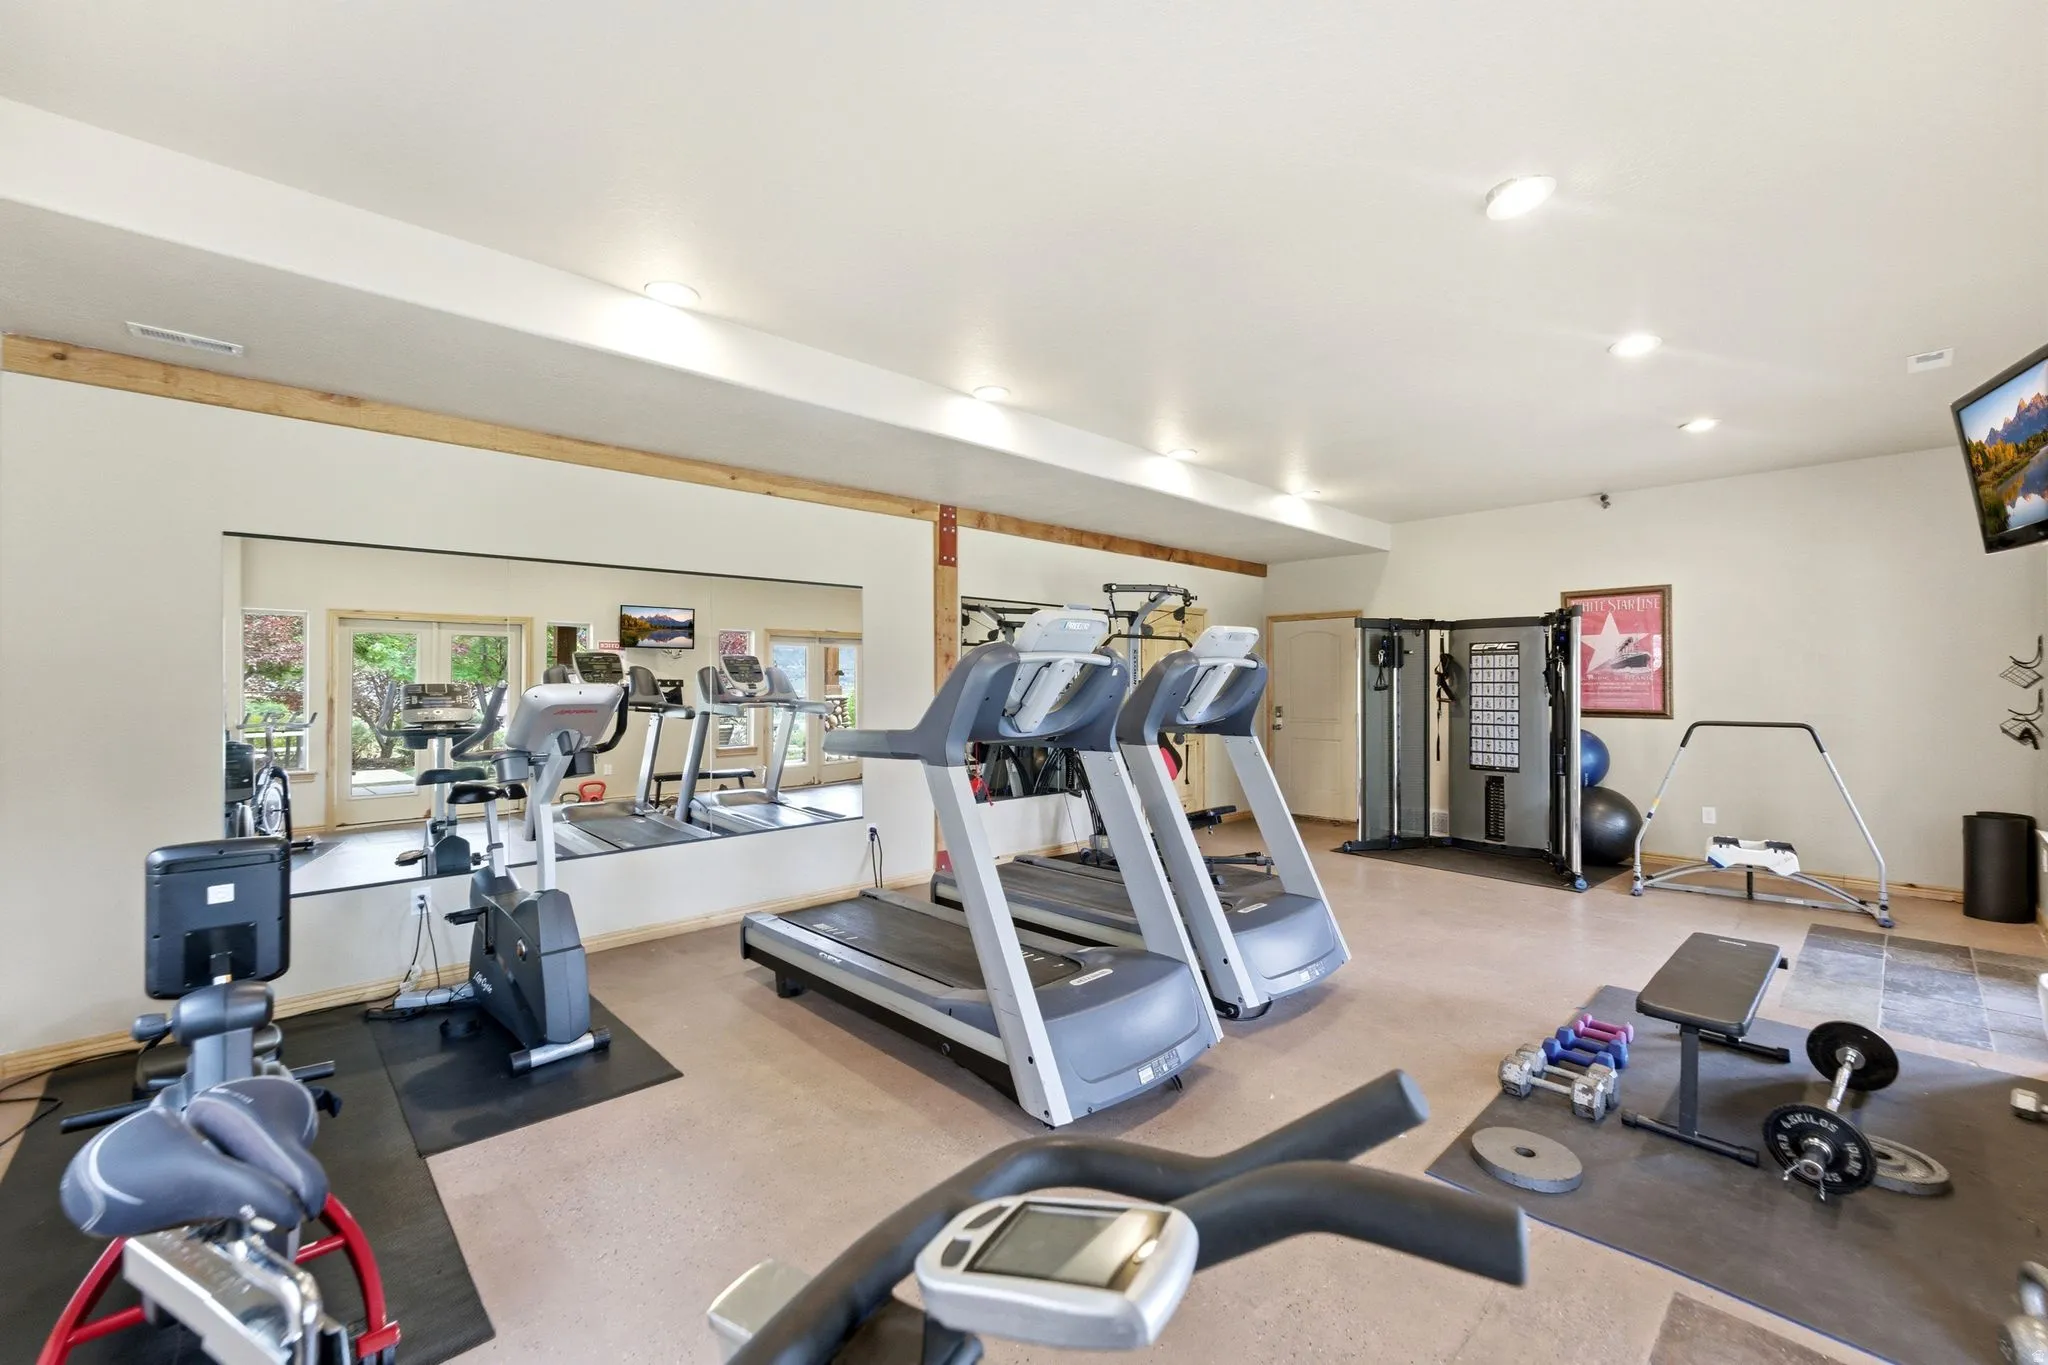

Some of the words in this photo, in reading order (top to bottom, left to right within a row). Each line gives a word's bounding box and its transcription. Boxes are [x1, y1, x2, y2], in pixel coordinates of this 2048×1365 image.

[1608, 599, 1634, 612] STAR
[1637, 596, 1660, 612] LINE
[1471, 642, 1518, 650] EPIC
